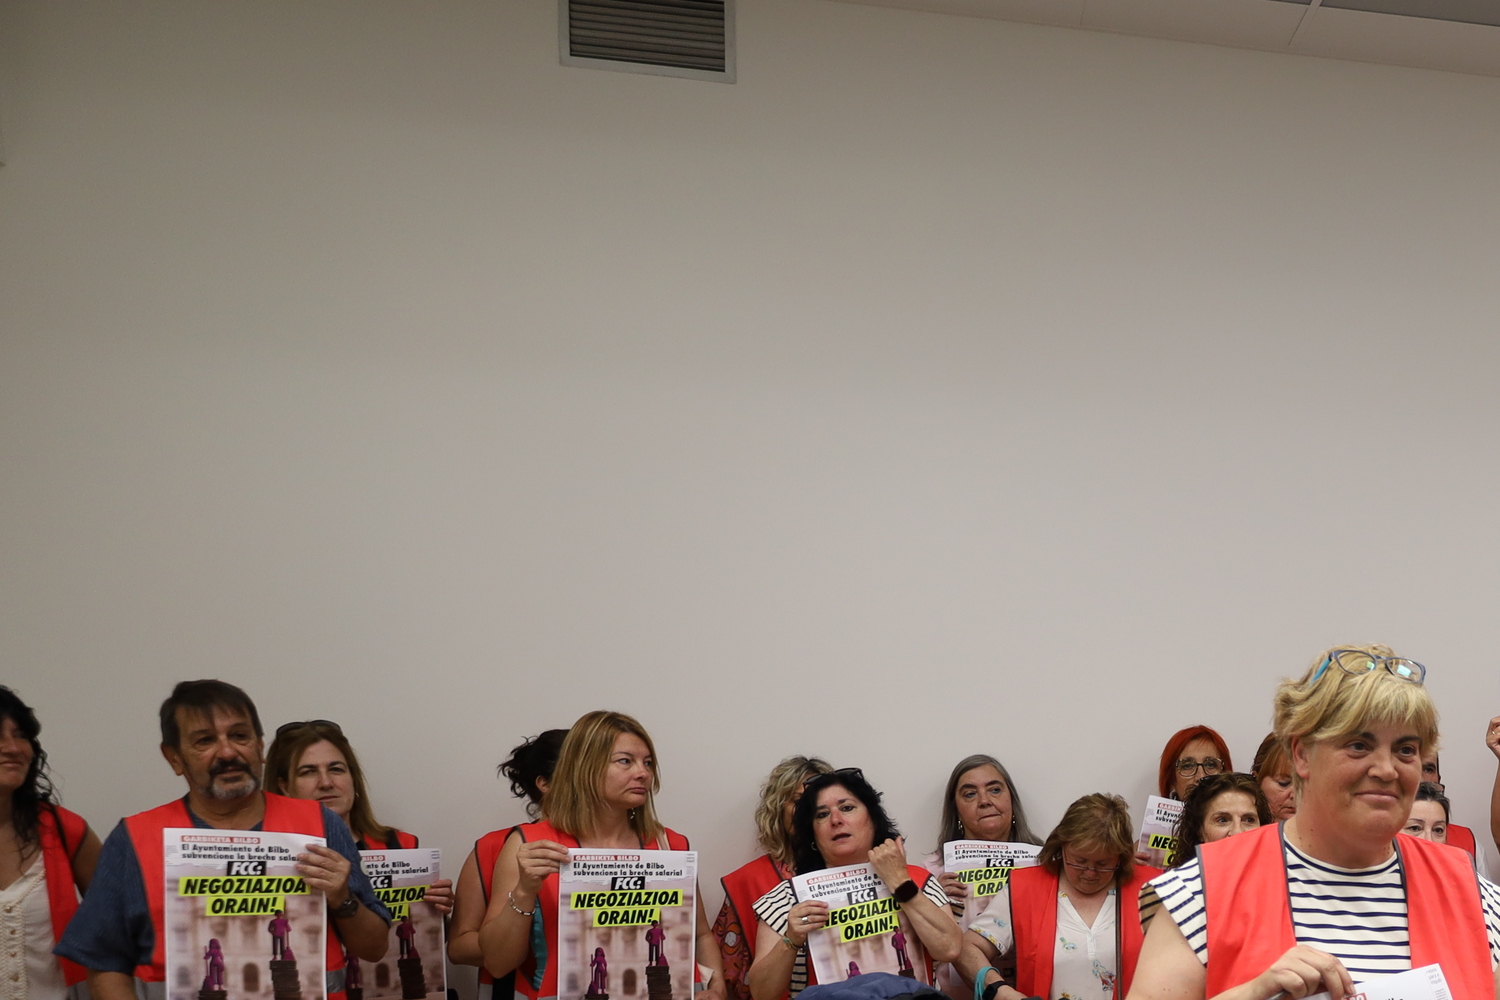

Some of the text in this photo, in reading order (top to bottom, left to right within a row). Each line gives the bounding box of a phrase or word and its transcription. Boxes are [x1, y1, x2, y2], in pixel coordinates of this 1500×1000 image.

[192, 844, 252, 852] Ayuntamiento
[249, 853, 276, 861] brecha
[231, 862, 262, 875] FCC:
[958, 868, 1010, 883] NEGOZI
[184, 878, 306, 894] NEGOZIAZIOA
[370, 877, 389, 889] CC:
[615, 877, 641, 890] FCC:
[812, 887, 850, 898] subvenciona
[860, 880, 881, 889] brecha
[817, 878, 859, 891] Ayuntamiento
[977, 882, 1003, 895] ORA
[376, 887, 425, 902] IAZIOA
[575, 891, 679, 908] NEGOZIAZIOA
[851, 889, 874, 904] FCC:
[212, 897, 277, 914] ORAIN!
[597, 909, 654, 925] ORAIN!
[844, 915, 893, 940] ORAIN!
